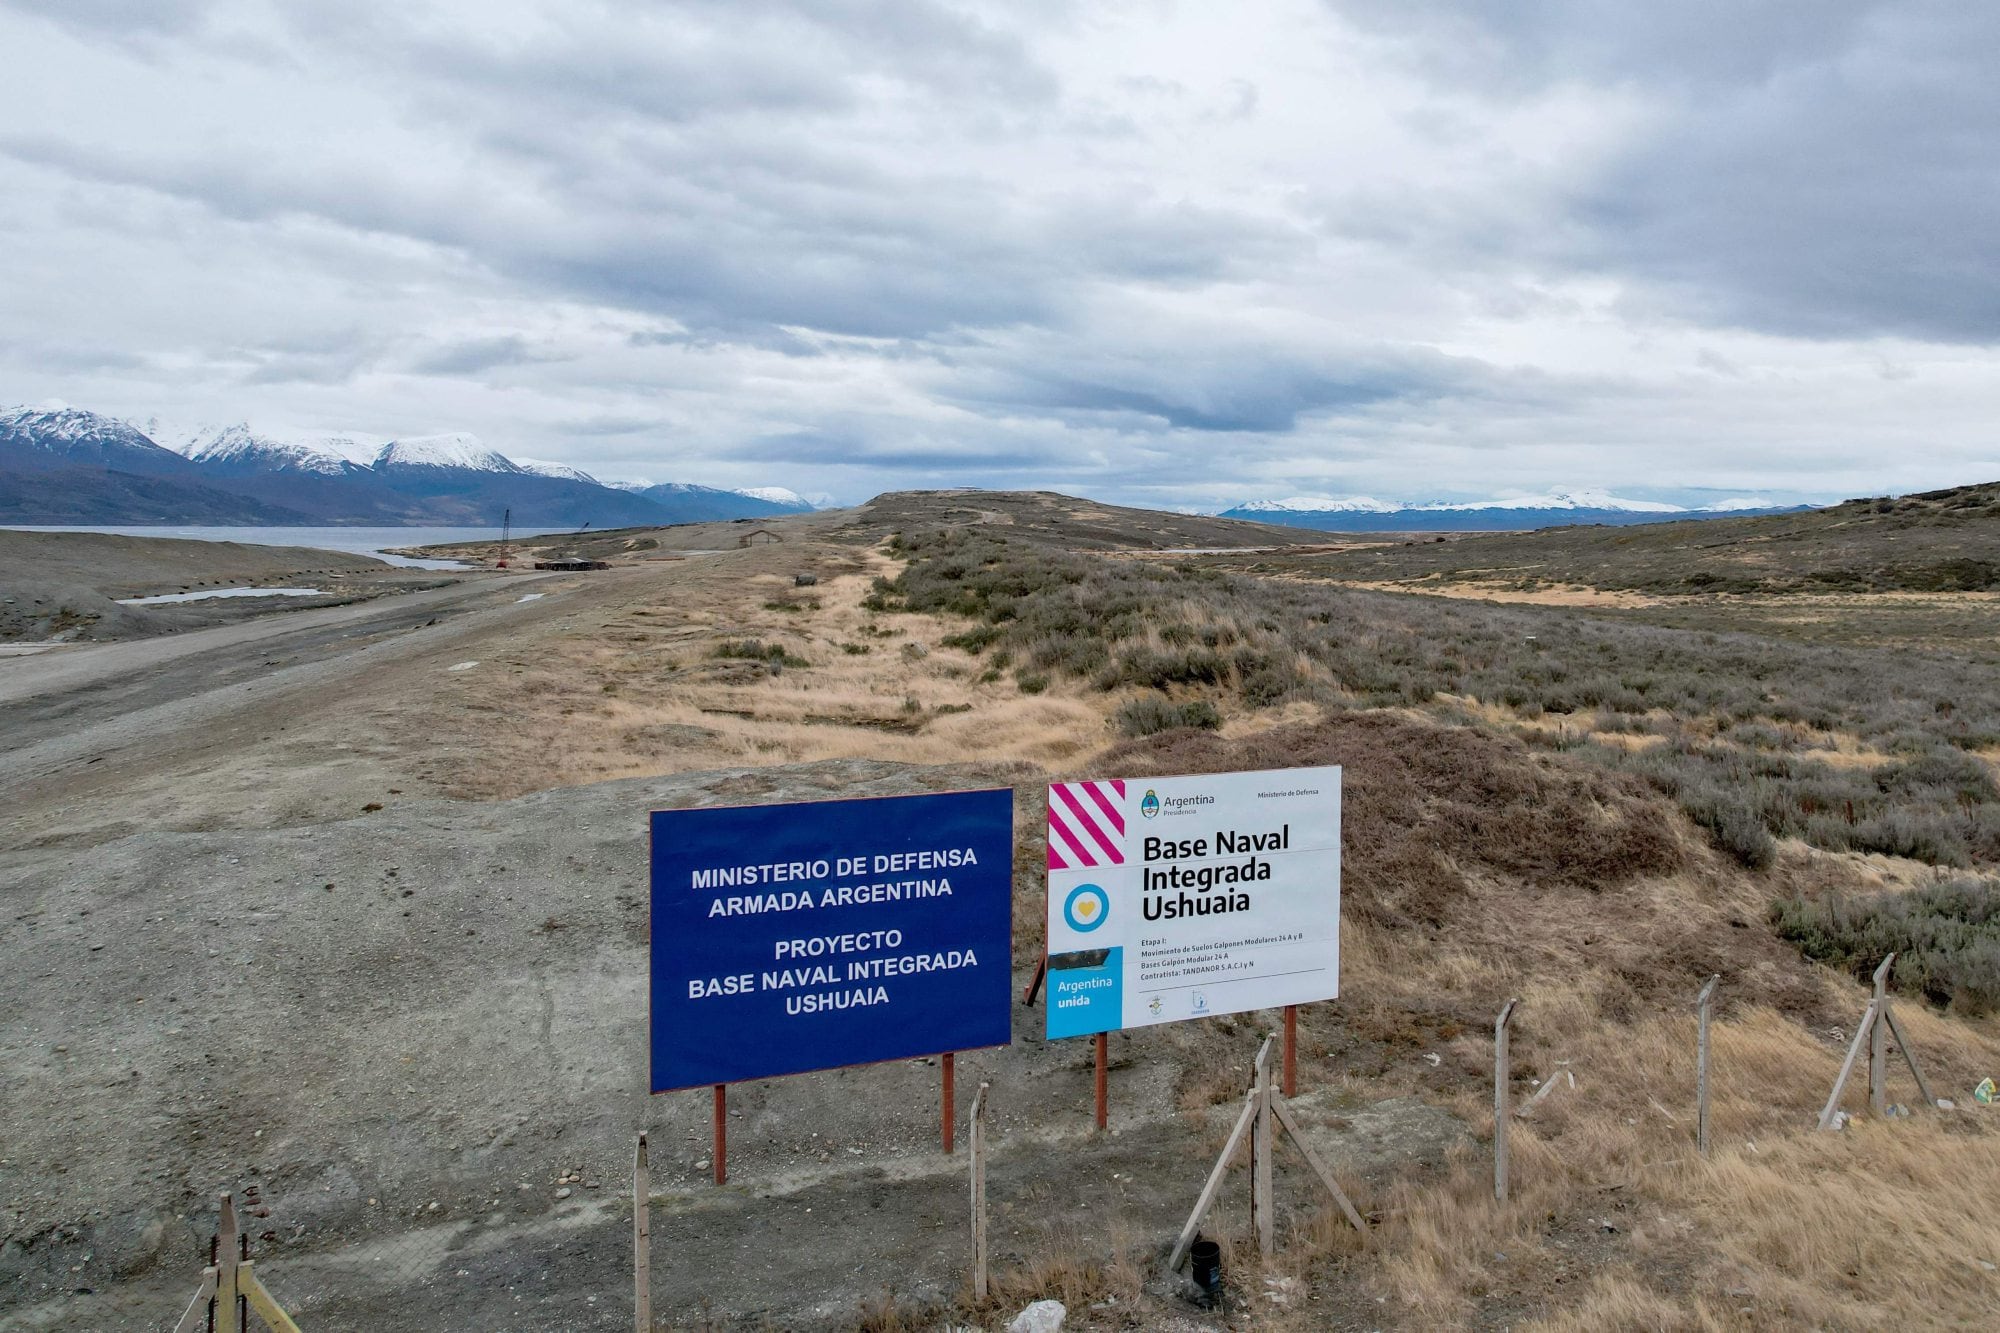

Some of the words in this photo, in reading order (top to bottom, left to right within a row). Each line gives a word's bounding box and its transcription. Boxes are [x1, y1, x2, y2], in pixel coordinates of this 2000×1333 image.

[1164, 794, 1215, 808] Argentina
[1257, 791, 1286, 799] Ministerio
[1295, 788, 1319, 796] Defensa
[1163, 808, 1197, 817] Presidencia
[1143, 836, 1208, 862] Base
[1216, 824, 1289, 855] Naval
[691, 859, 830, 889] MINISTERIO
[836, 857, 867, 876] DE
[874, 848, 978, 873] DEFENSA
[1143, 856, 1271, 893] Integrada
[708, 892, 814, 918] ARMADA
[820, 878, 952, 907] ARGENTINA
[1143, 887, 1250, 921] Ushuaia
[775, 929, 902, 960] PROYECTO
[1141, 939, 1161, 947] Etapa
[1141, 949, 1181, 958] Movimiento
[1191, 943, 1213, 952] Suelos
[1214, 941, 1244, 949] Galpones
[1245, 937, 1278, 945] Modulares
[1141, 961, 1161, 969] Bases
[1186, 955, 1214, 963] Modular
[688, 974, 754, 999] BASE
[762, 965, 841, 990] NAVAL
[848, 949, 978, 980] INTEGRADA
[1140, 970, 1181, 981] Contratista:
[1182, 965, 1220, 975] TANDANOR
[1058, 977, 1112, 993] Argentina
[786, 986, 889, 1015] USHUAIA
[1058, 995, 1090, 1009] unida
